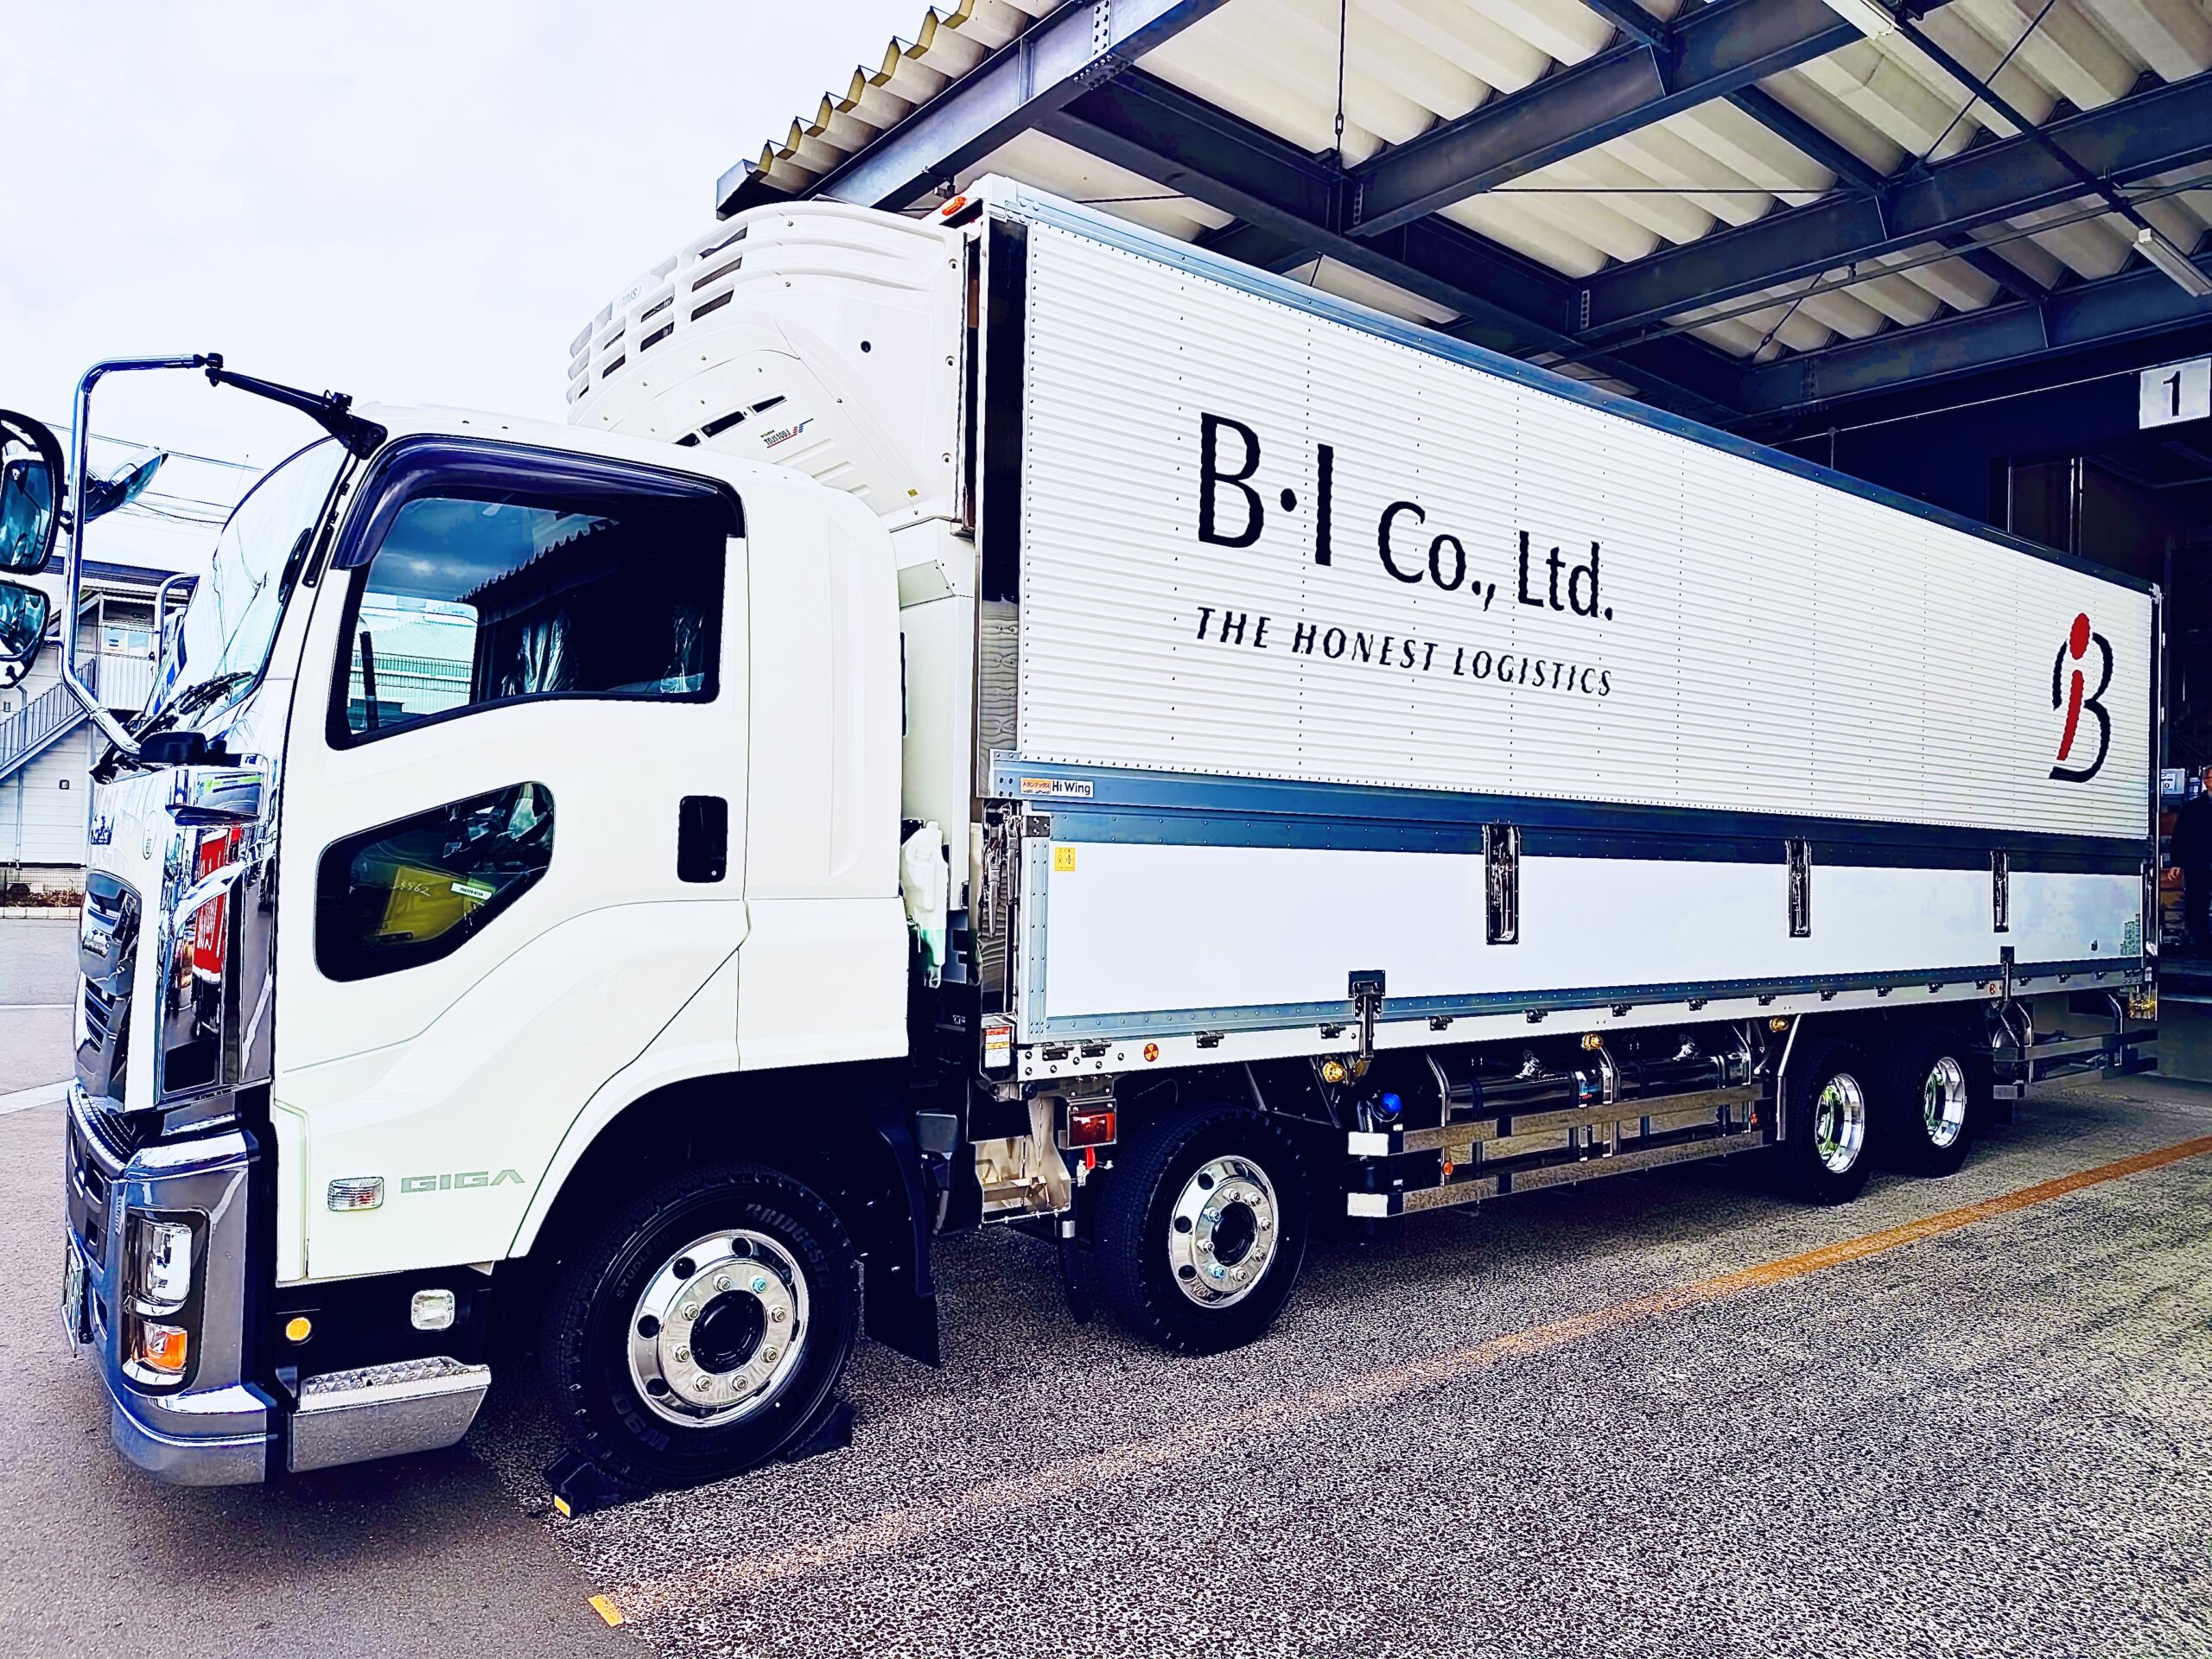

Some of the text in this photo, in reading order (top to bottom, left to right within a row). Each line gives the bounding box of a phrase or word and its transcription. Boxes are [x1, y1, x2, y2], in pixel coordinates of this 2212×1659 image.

[2163, 370, 2180, 417] 1
[1377, 500, 1496, 612] Co.,
[1517, 530, 1613, 620] Ltd.
[1197, 607, 1613, 697] THE HONEST LOGISTICS
[1052, 780, 1090, 796] Hi Wing
[400, 1169, 525, 1194] GIGA
